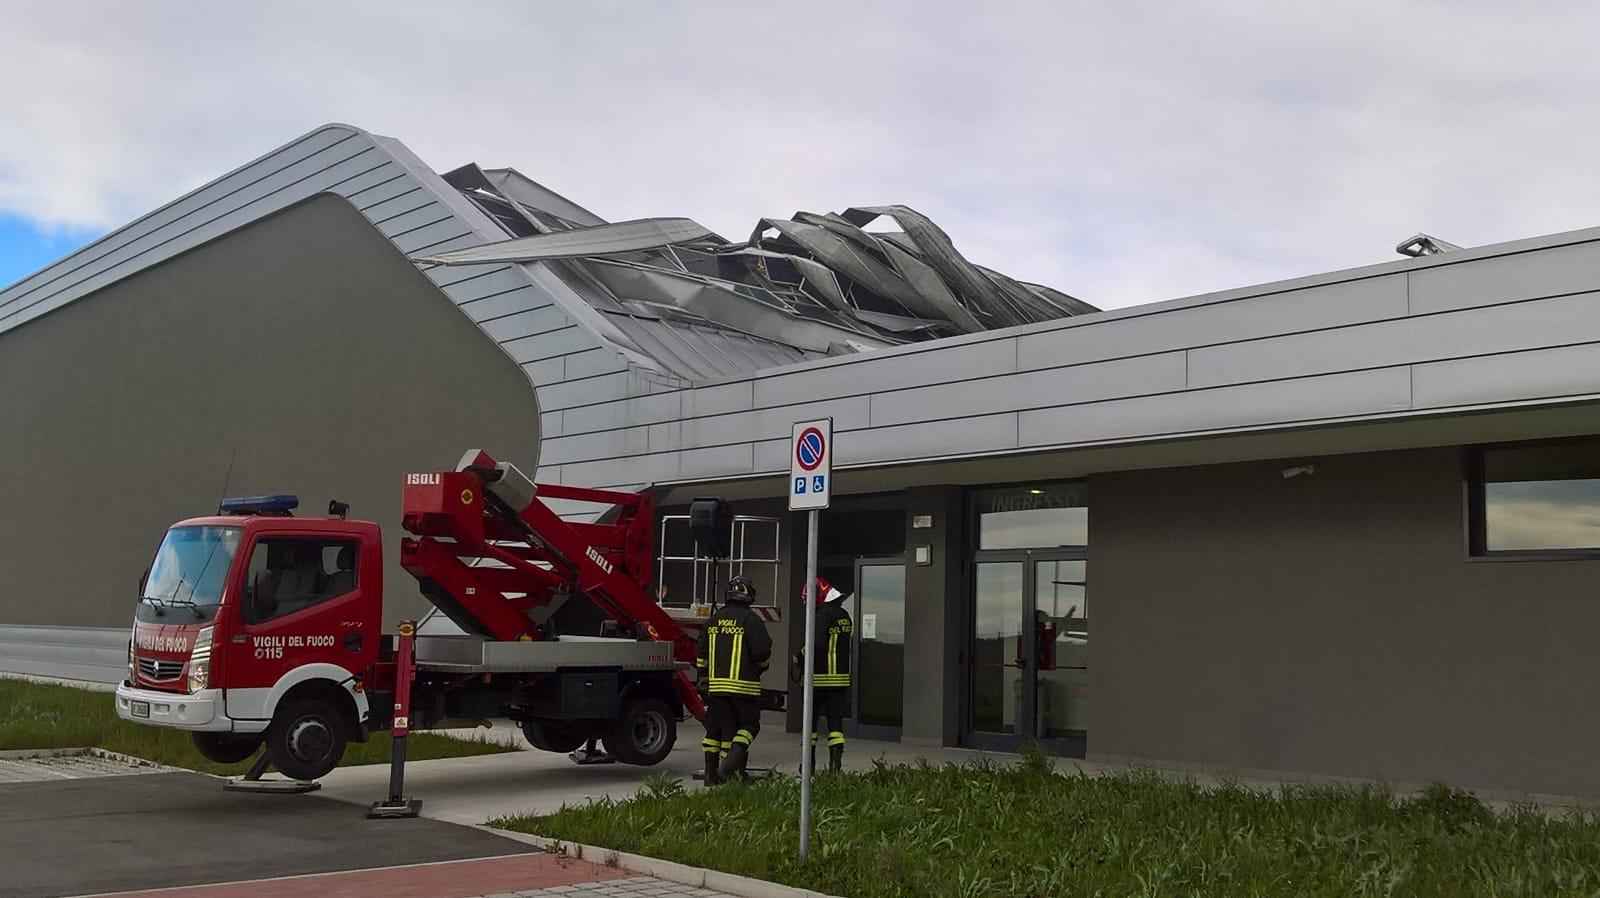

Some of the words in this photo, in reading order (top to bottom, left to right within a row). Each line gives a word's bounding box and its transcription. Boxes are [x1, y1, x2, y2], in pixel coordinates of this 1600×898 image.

[407, 473, 440, 485] ISOLI
[797, 479, 805, 492] P
[585, 545, 613, 575] ISOLI
[707, 626, 719, 634] DEL
[155, 635, 165, 651] DEL
[166, 636, 187, 653] FUOCO
[253, 636, 285, 648] VIGILI
[288, 636, 304, 647] DEL
[306, 635, 335, 647] FUOCO
[265, 647, 283, 659] 115
